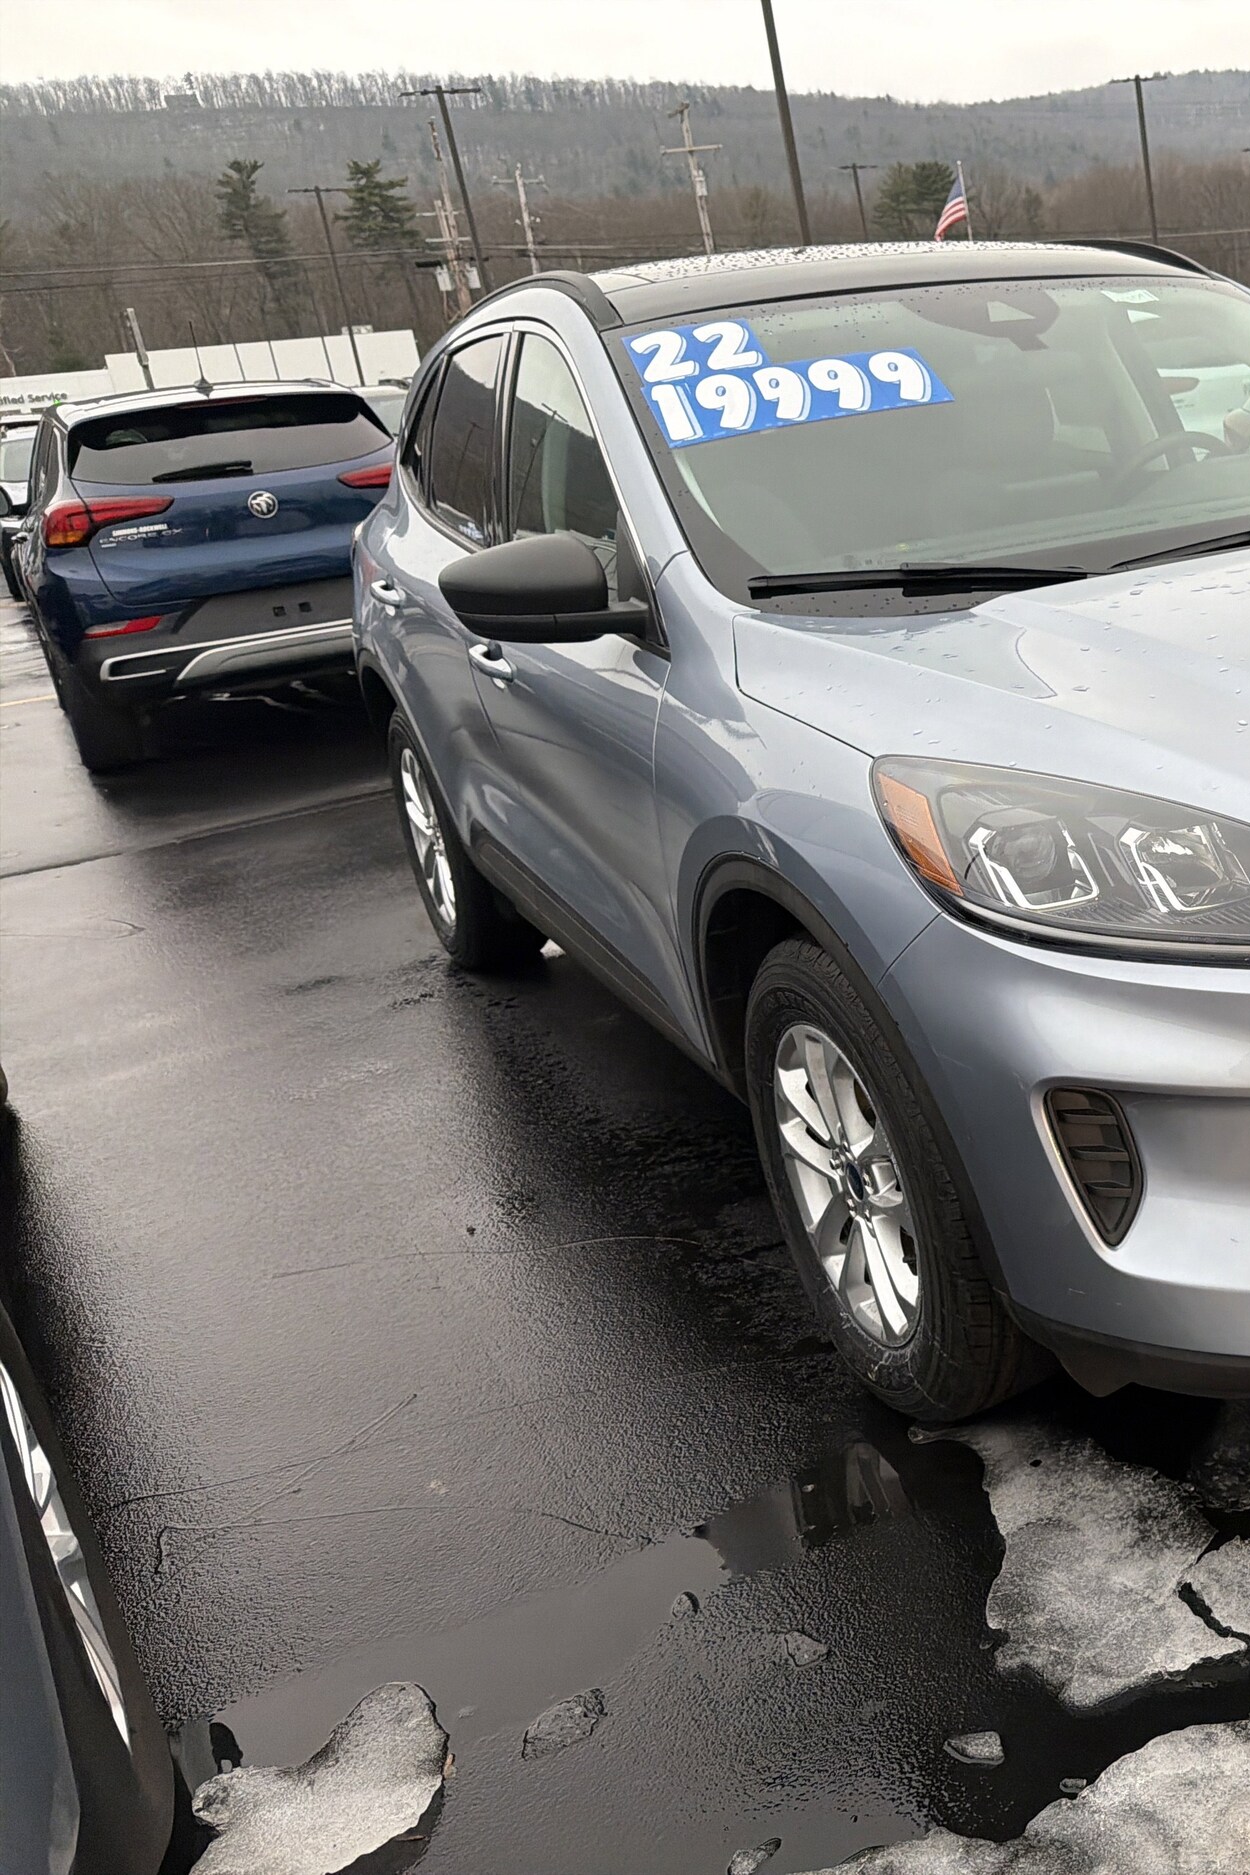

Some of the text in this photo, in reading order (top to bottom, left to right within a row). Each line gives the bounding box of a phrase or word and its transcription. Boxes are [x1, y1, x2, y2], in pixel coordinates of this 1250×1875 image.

[630, 321, 763, 384] 22
[27, 391, 68, 403] Service
[650, 351, 932, 442] 19999
